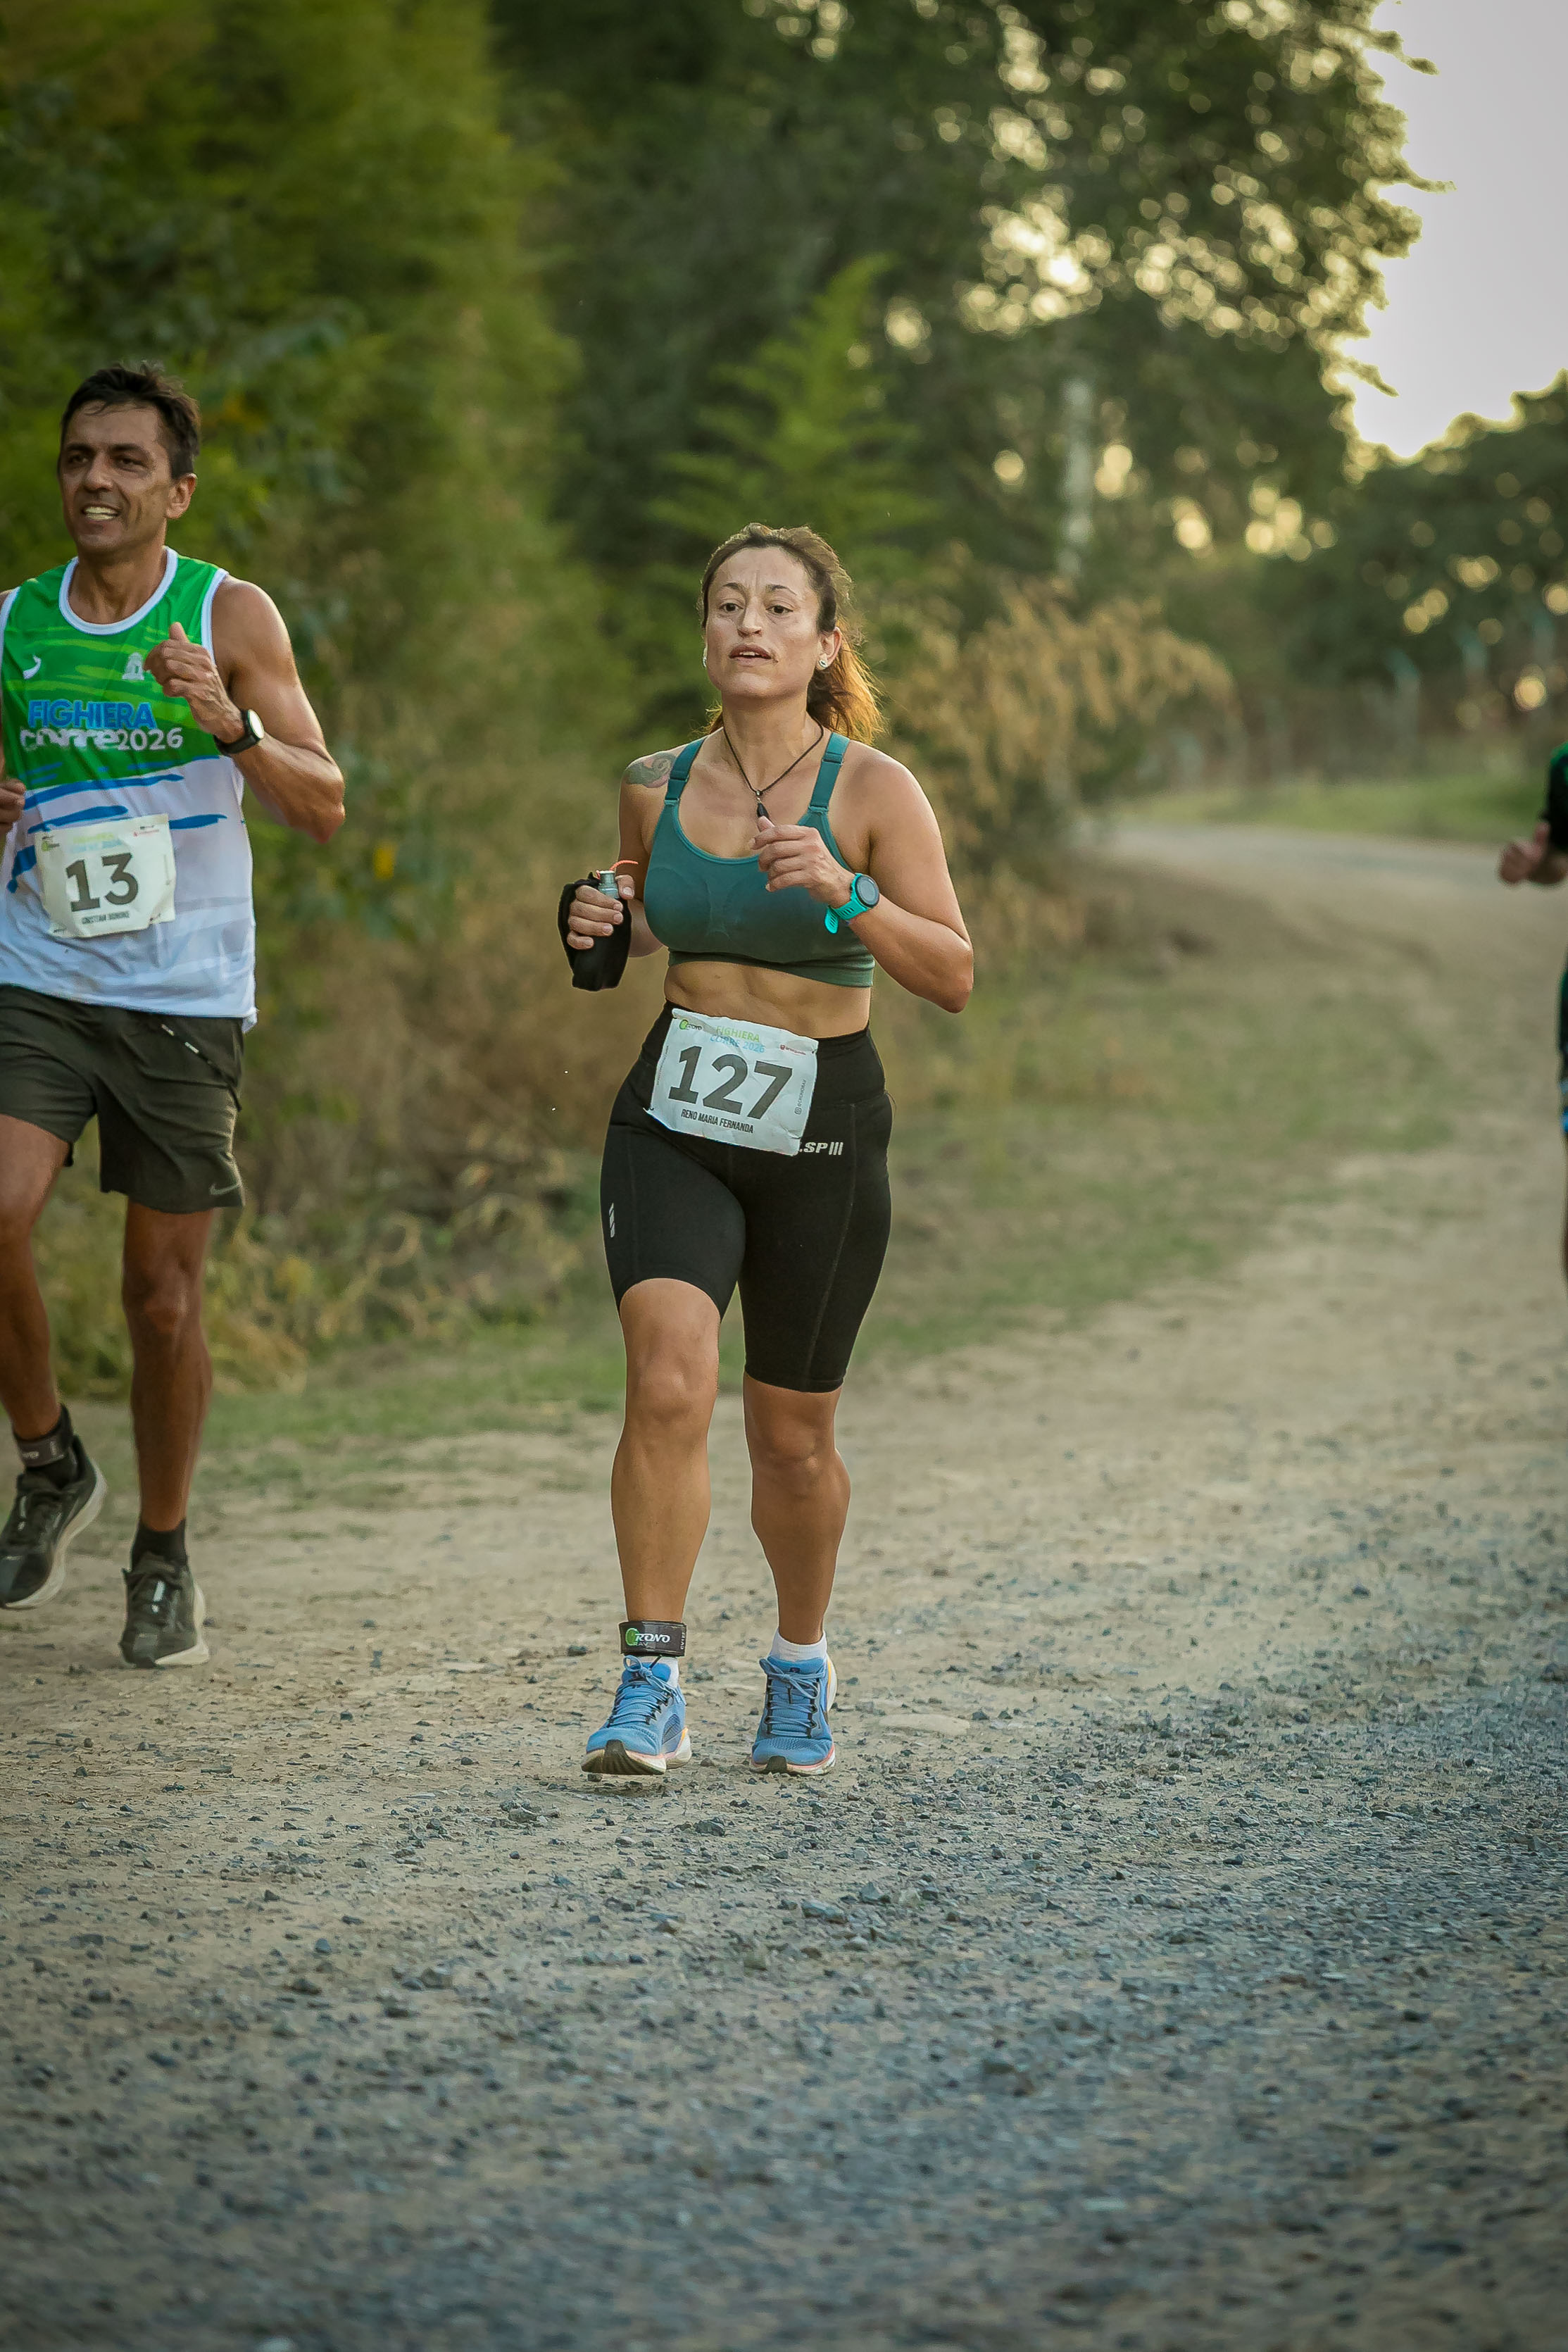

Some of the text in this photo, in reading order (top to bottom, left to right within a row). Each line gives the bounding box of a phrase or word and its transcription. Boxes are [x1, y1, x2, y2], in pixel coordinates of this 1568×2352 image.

[27, 699, 157, 730] FIGHIERA
[65, 852, 139, 912] 13
[716, 1025, 760, 1042] FIGHIERA
[742, 1041, 765, 1053] 2026
[668, 1046, 793, 1120] 127
[681, 1108, 754, 1134] RENO MARIA FERNANDA
